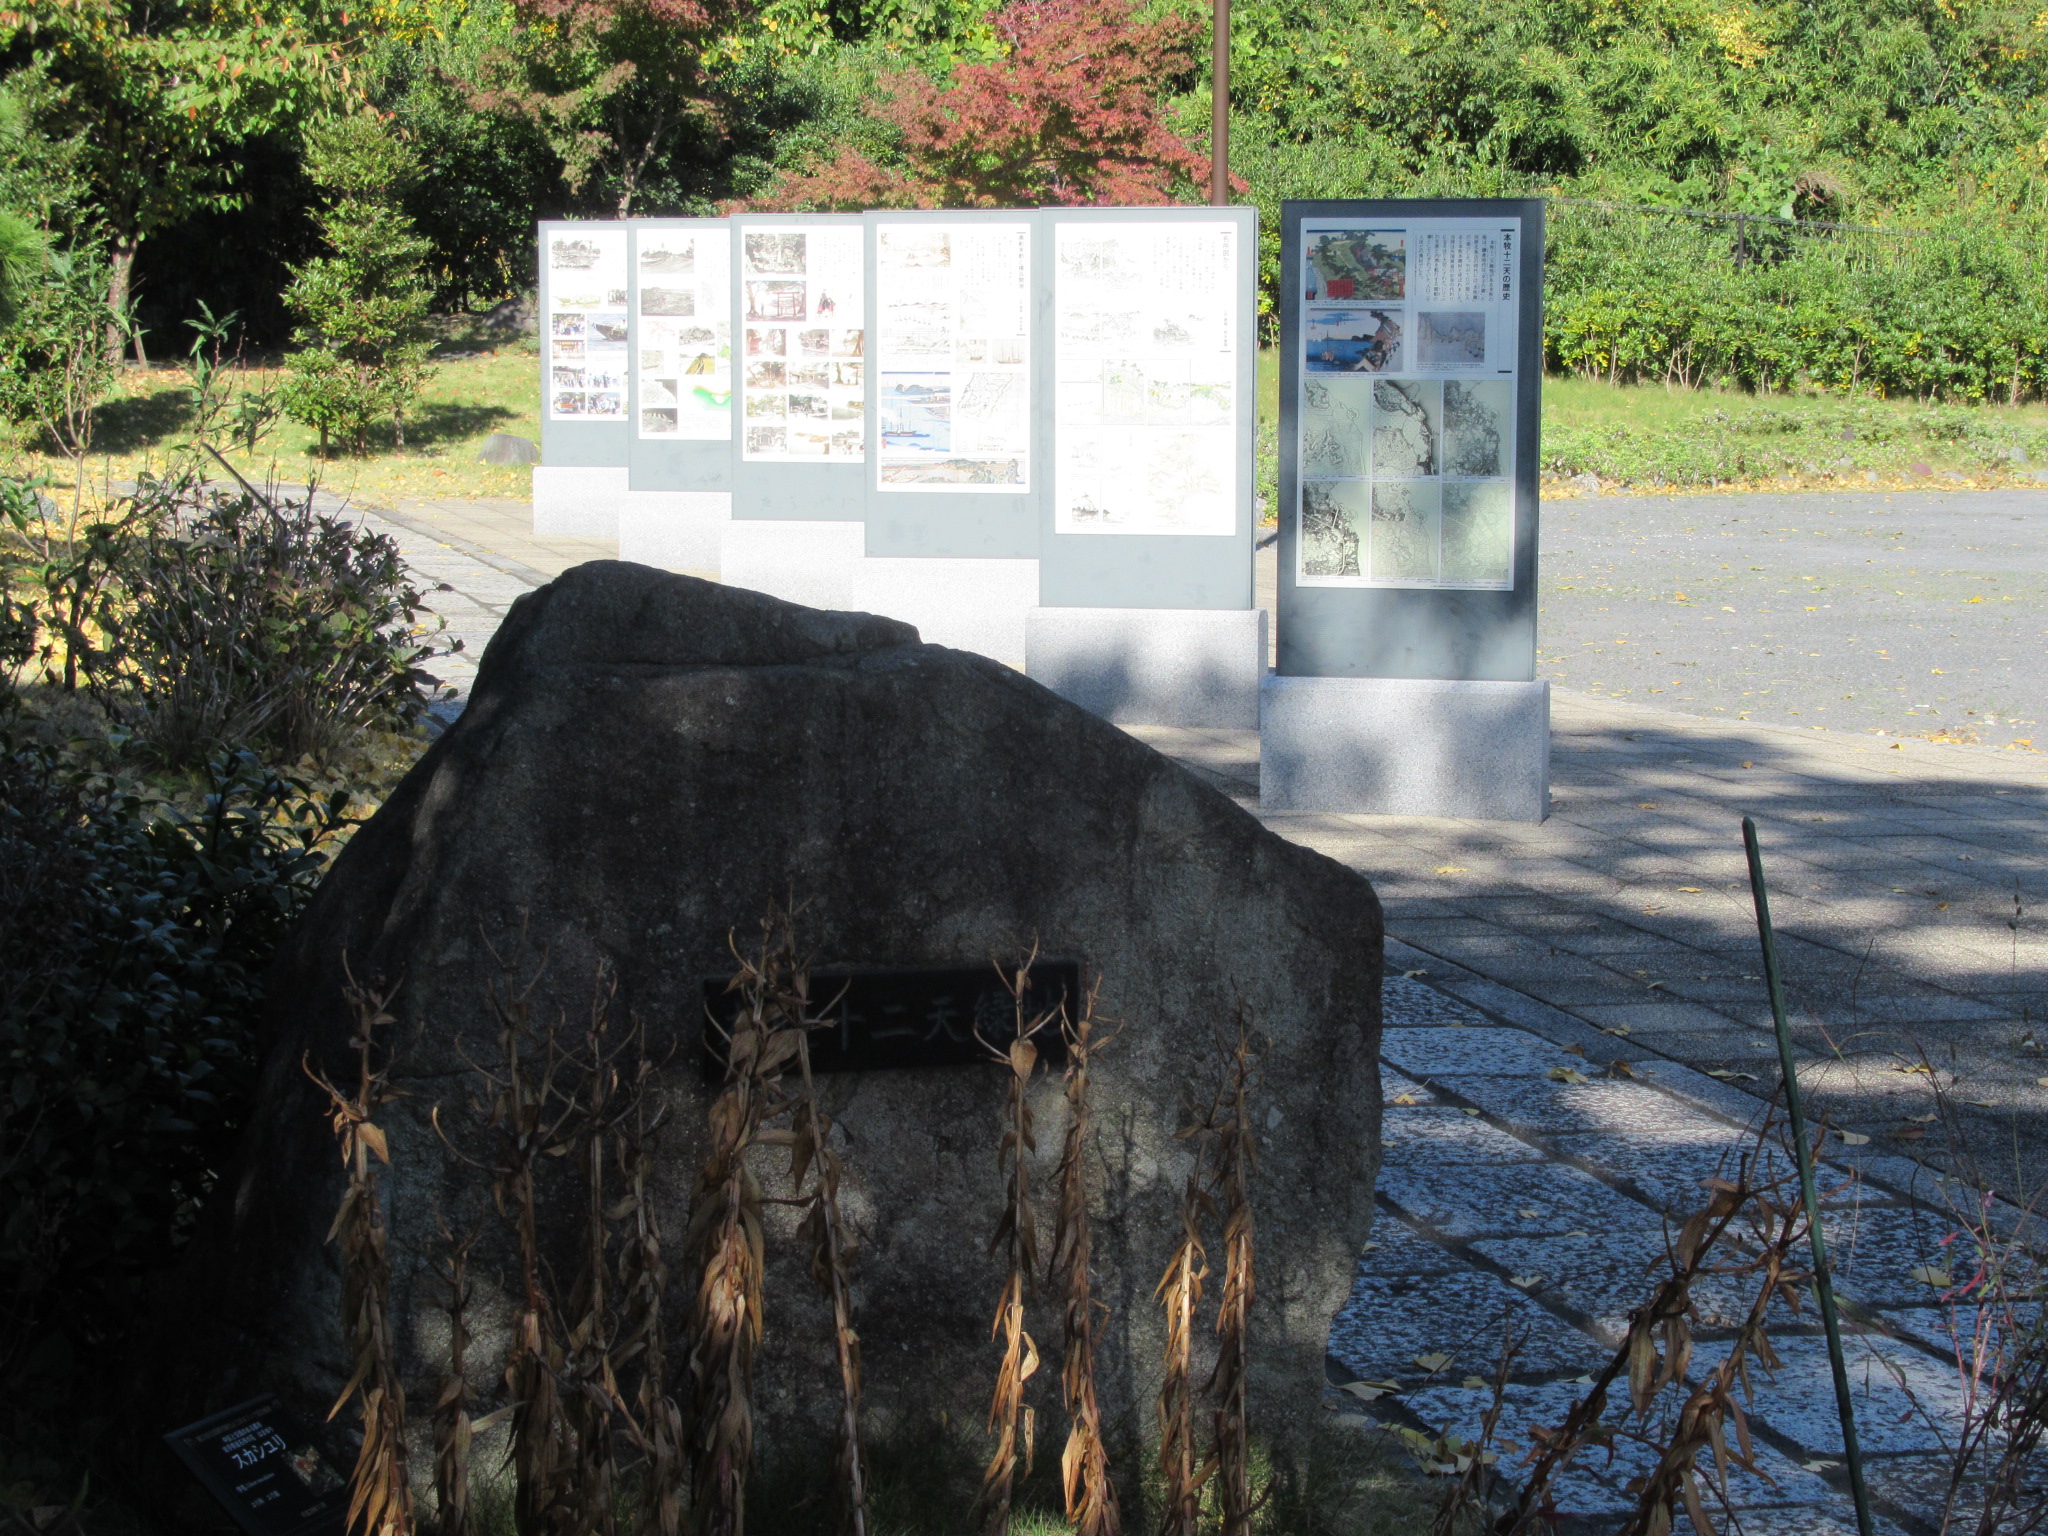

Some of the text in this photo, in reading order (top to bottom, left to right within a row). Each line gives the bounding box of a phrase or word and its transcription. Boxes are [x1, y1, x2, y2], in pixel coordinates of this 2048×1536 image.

[1502, 234, 1512, 301] 本牧十二天の歴史
[717, 986, 1062, 1052] 十二天緑地
[231, 1434, 286, 1469] スカシユリ
